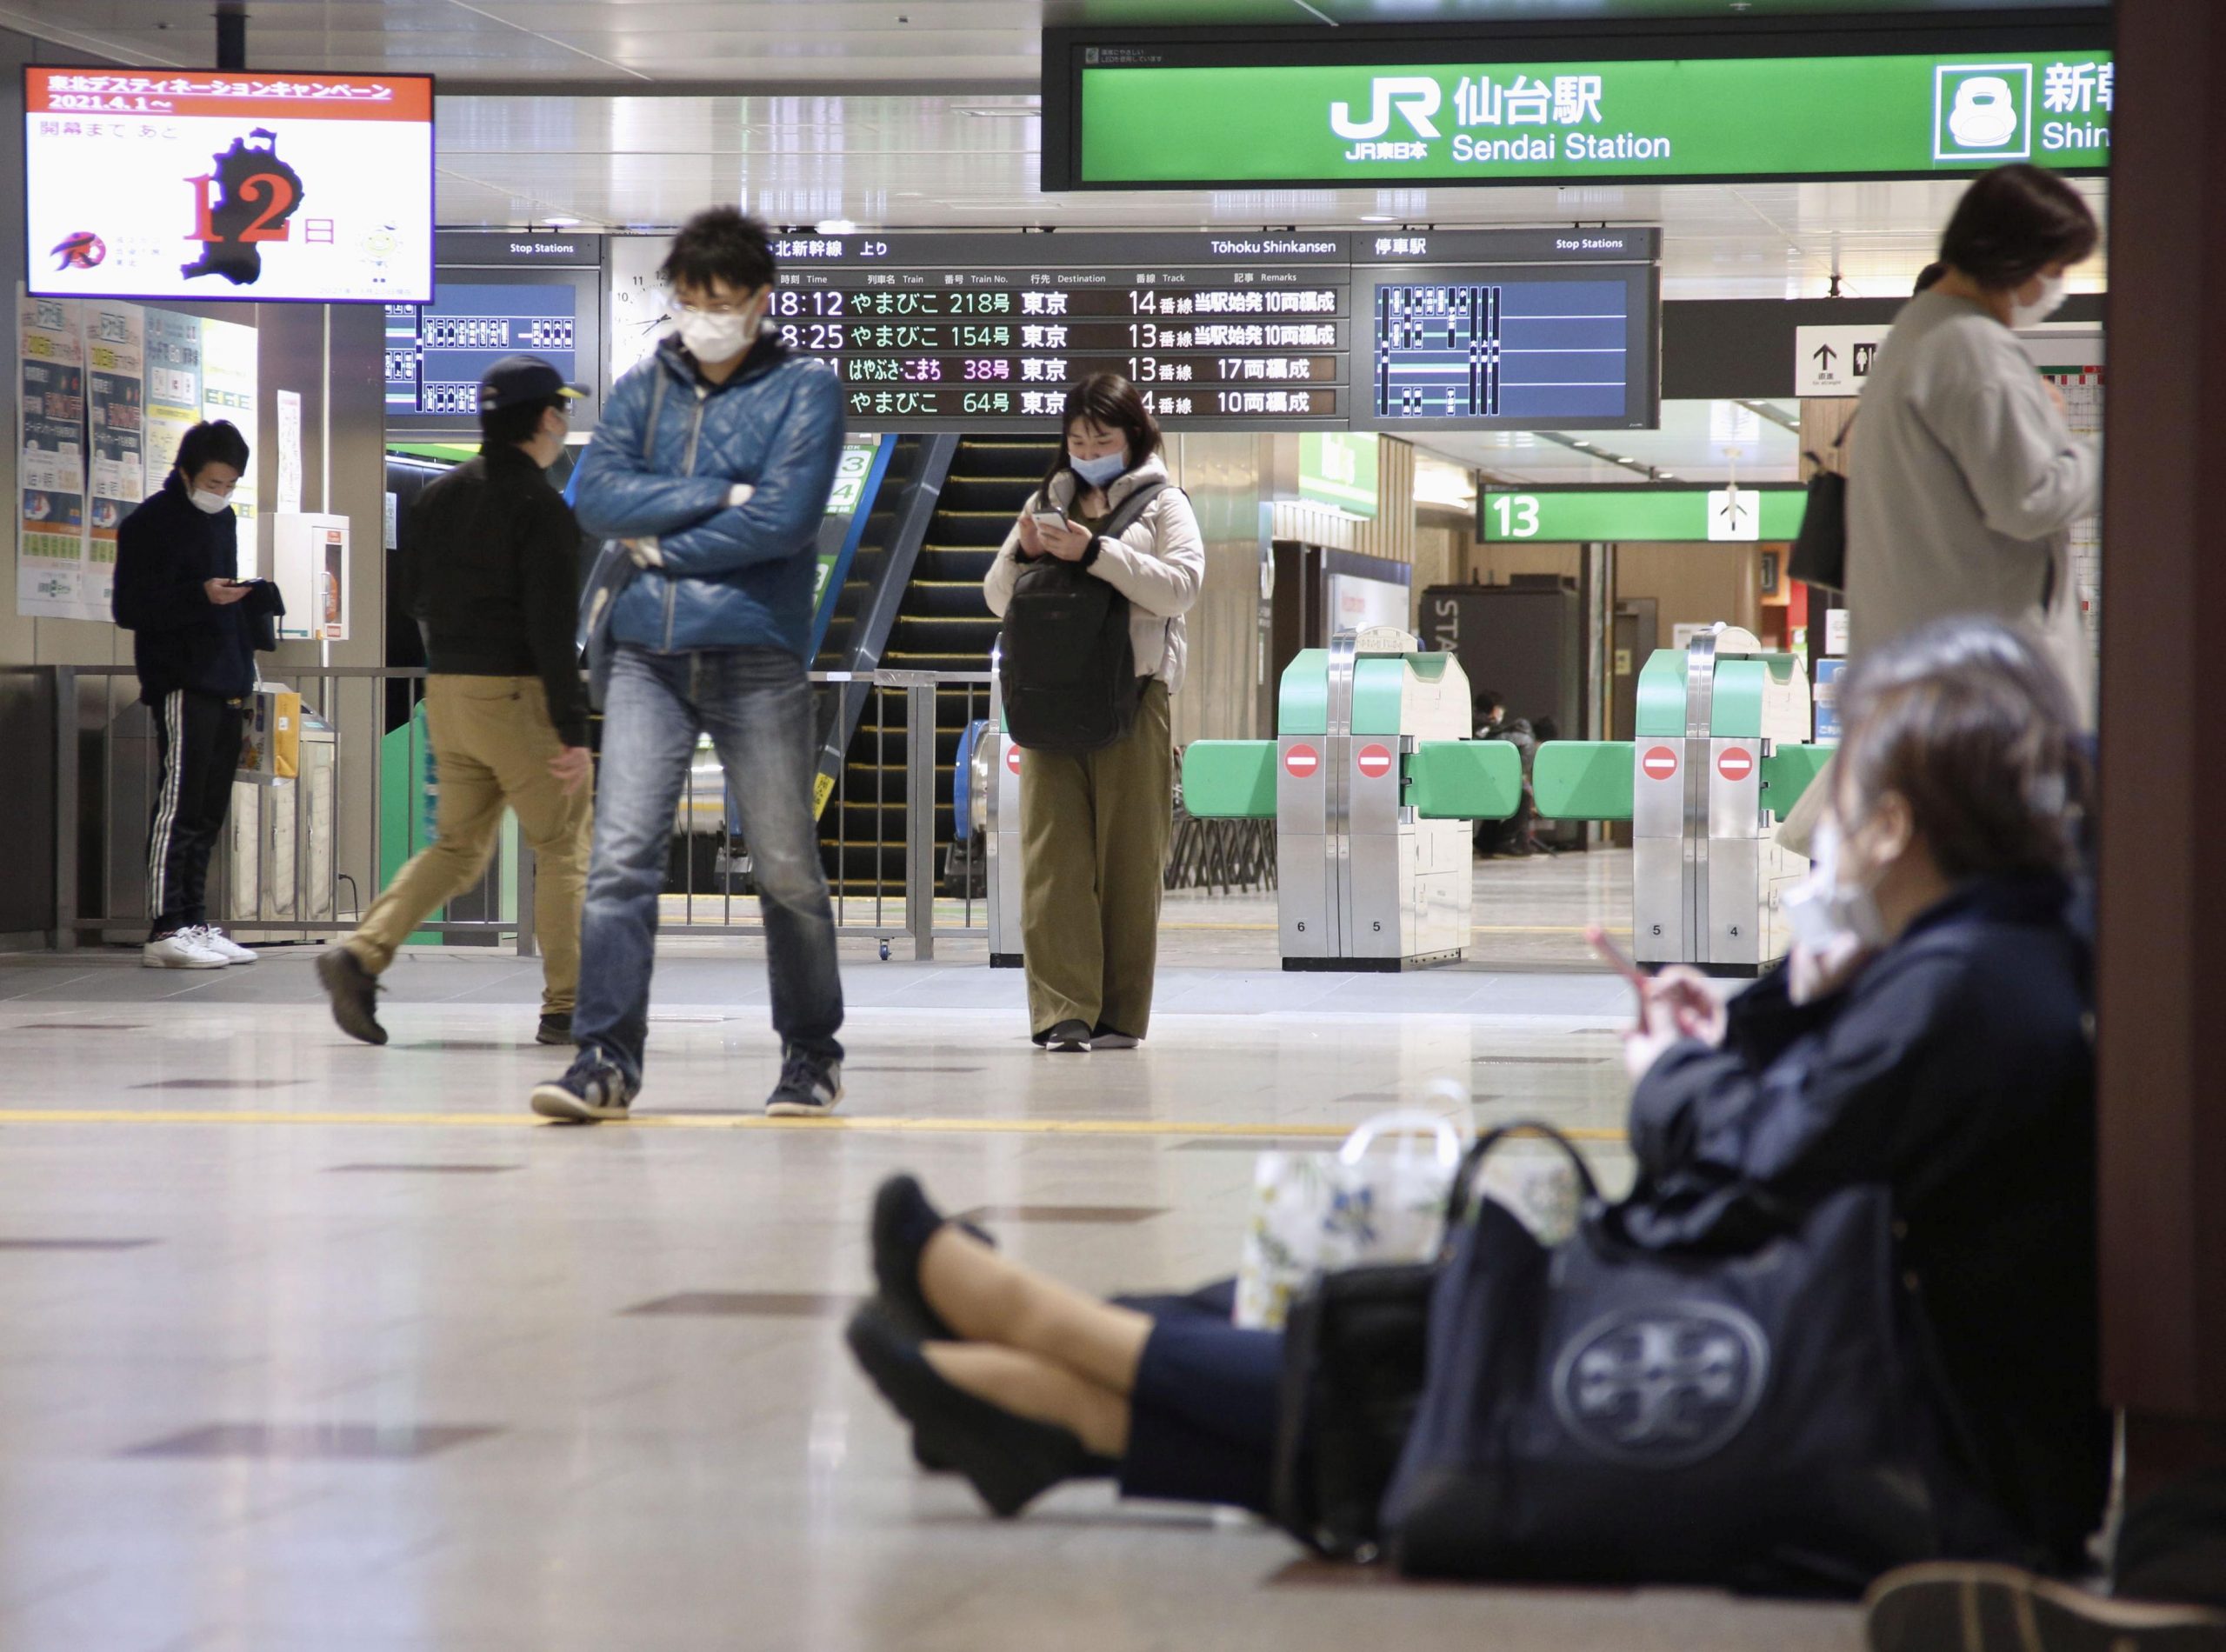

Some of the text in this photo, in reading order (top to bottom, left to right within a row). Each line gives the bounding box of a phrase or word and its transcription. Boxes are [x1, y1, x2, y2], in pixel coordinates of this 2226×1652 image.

[47, 75, 392, 99] 東北デスティネーションキャンペーン
[1454, 75, 1603, 125] 仙台駅
[1330, 77, 1441, 139] JR
[1345, 142, 1428, 161] JR東日本
[1452, 132, 1670, 161] Sendai Station
[510, 243, 574, 255] Stop Stations
[769, 241, 888, 256] 北新幹線 上り
[1211, 240, 1336, 253] Tōhoku Shinkansen
[1375, 238, 1427, 255] 停車駅
[1556, 238, 1623, 250] Stop Stations
[632, 276, 643, 285] 11
[780, 275, 800, 284] 時刻
[867, 275, 896, 284] 列車名
[944, 275, 963, 284] 番号
[1030, 274, 1050, 284] 行先
[1057, 274, 1106, 283] Destination
[1136, 273, 1156, 283] 番線
[1163, 274, 1185, 283] Track
[1234, 273, 1254, 283] 記事
[1261, 273, 1296, 282] Remarks
[618, 292, 629, 302] 10
[767, 291, 843, 316] 18:12
[850, 292, 938, 314] やまびこ
[950, 293, 1010, 314] 218号
[1022, 291, 1068, 316] 東京
[1130, 290, 1193, 315] 14番線
[850, 325, 938, 347] やまびこ
[951, 326, 1010, 347] 154号
[1022, 325, 1068, 349] 東京
[1129, 324, 1193, 348] 13番線
[964, 360, 1010, 380] 38号
[1021, 358, 1068, 382] 東京
[1129, 357, 1192, 381] 13番線
[1218, 358, 1310, 380] 17両編成
[850, 391, 938, 413] やまびこ
[963, 393, 1009, 413] 64号
[1021, 390, 1064, 414] 東京
[1218, 391, 1310, 413] 10両編成
[842, 456, 865, 472] 3
[832, 484, 854, 500] 4
[1494, 495, 1540, 537] 13
[1296, 922, 1305, 932] 6
[1372, 921, 1381, 932] 5
[1652, 924, 1661, 936] 5
[1729, 925, 1738, 936] 4
